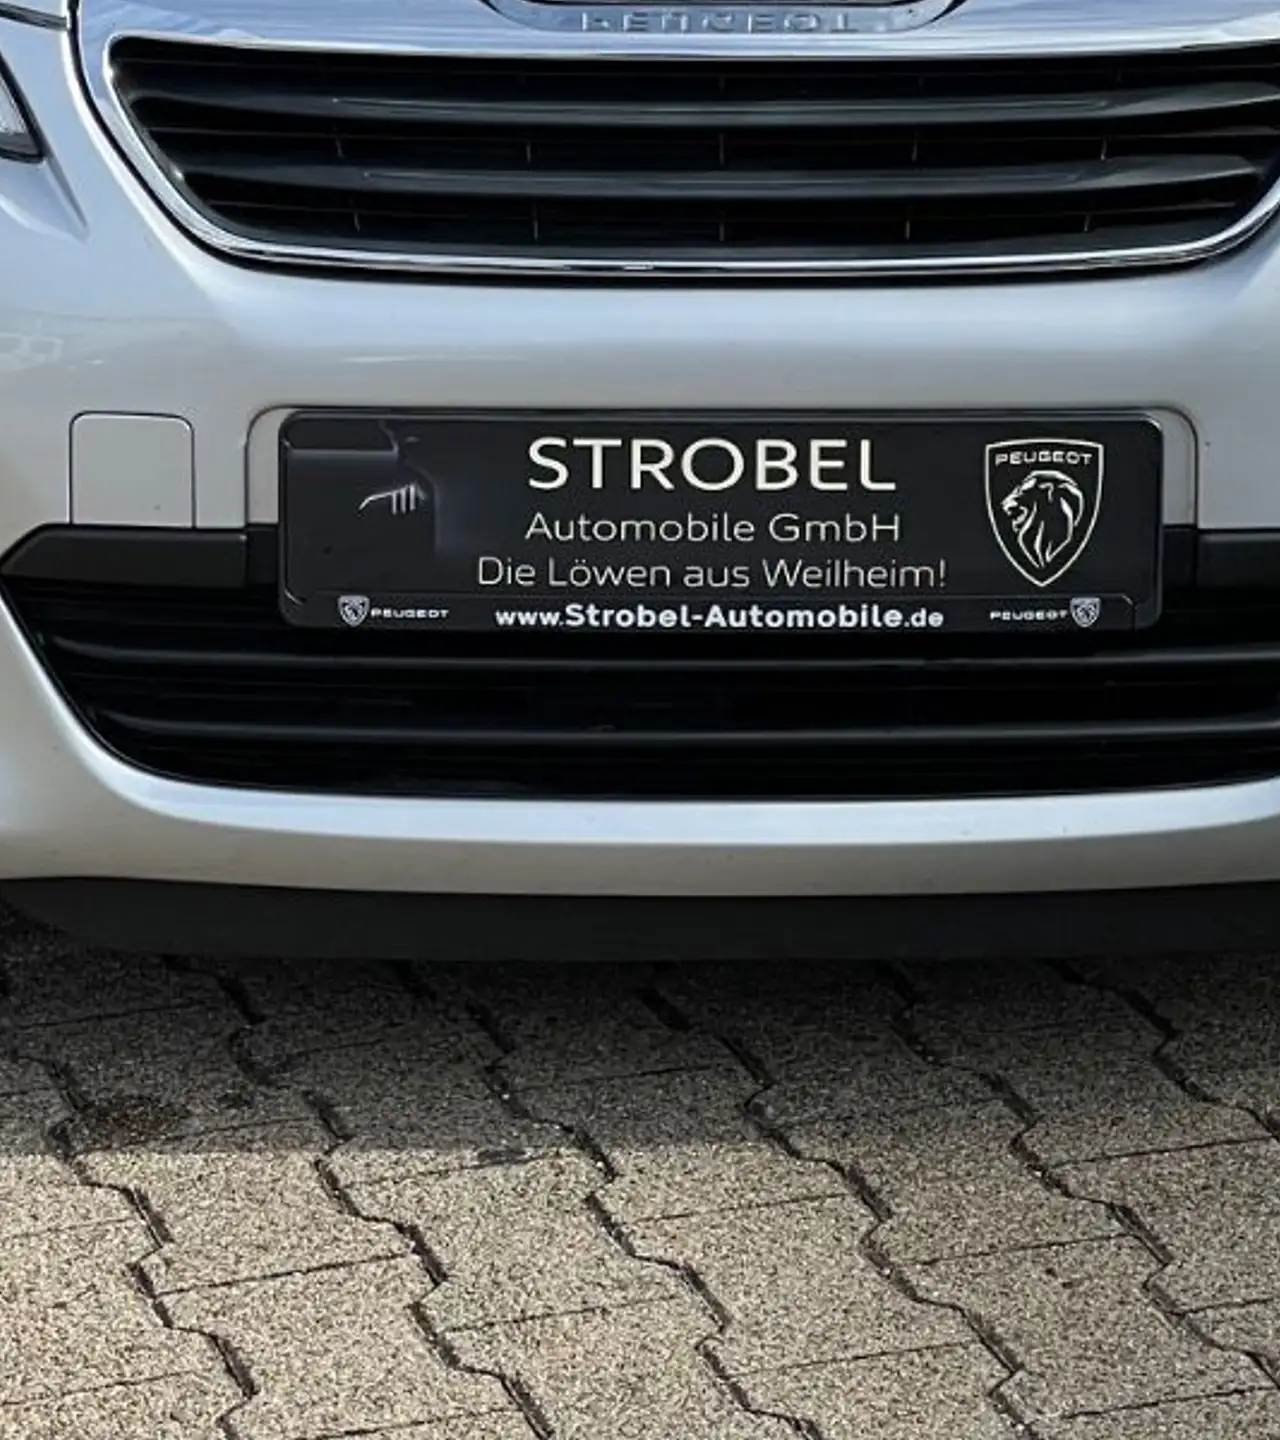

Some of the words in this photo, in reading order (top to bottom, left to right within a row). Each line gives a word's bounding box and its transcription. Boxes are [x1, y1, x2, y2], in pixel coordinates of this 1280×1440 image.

[528, 436, 896, 491] STROBEL
[994, 450, 1092, 466] PEUGEOT
[525, 512, 756, 542] Automobile
[768, 512, 900, 542] GmbH
[477, 556, 537, 587] Die
[548, 556, 671, 587] Löwen
[683, 563, 751, 588] aus
[762, 558, 947, 588] Weilheim!
[370, 609, 450, 620] PEUGEOT
[494, 603, 945, 629] www.Strobel-Automobile.de
[989, 609, 1069, 621] PEUGEOT
